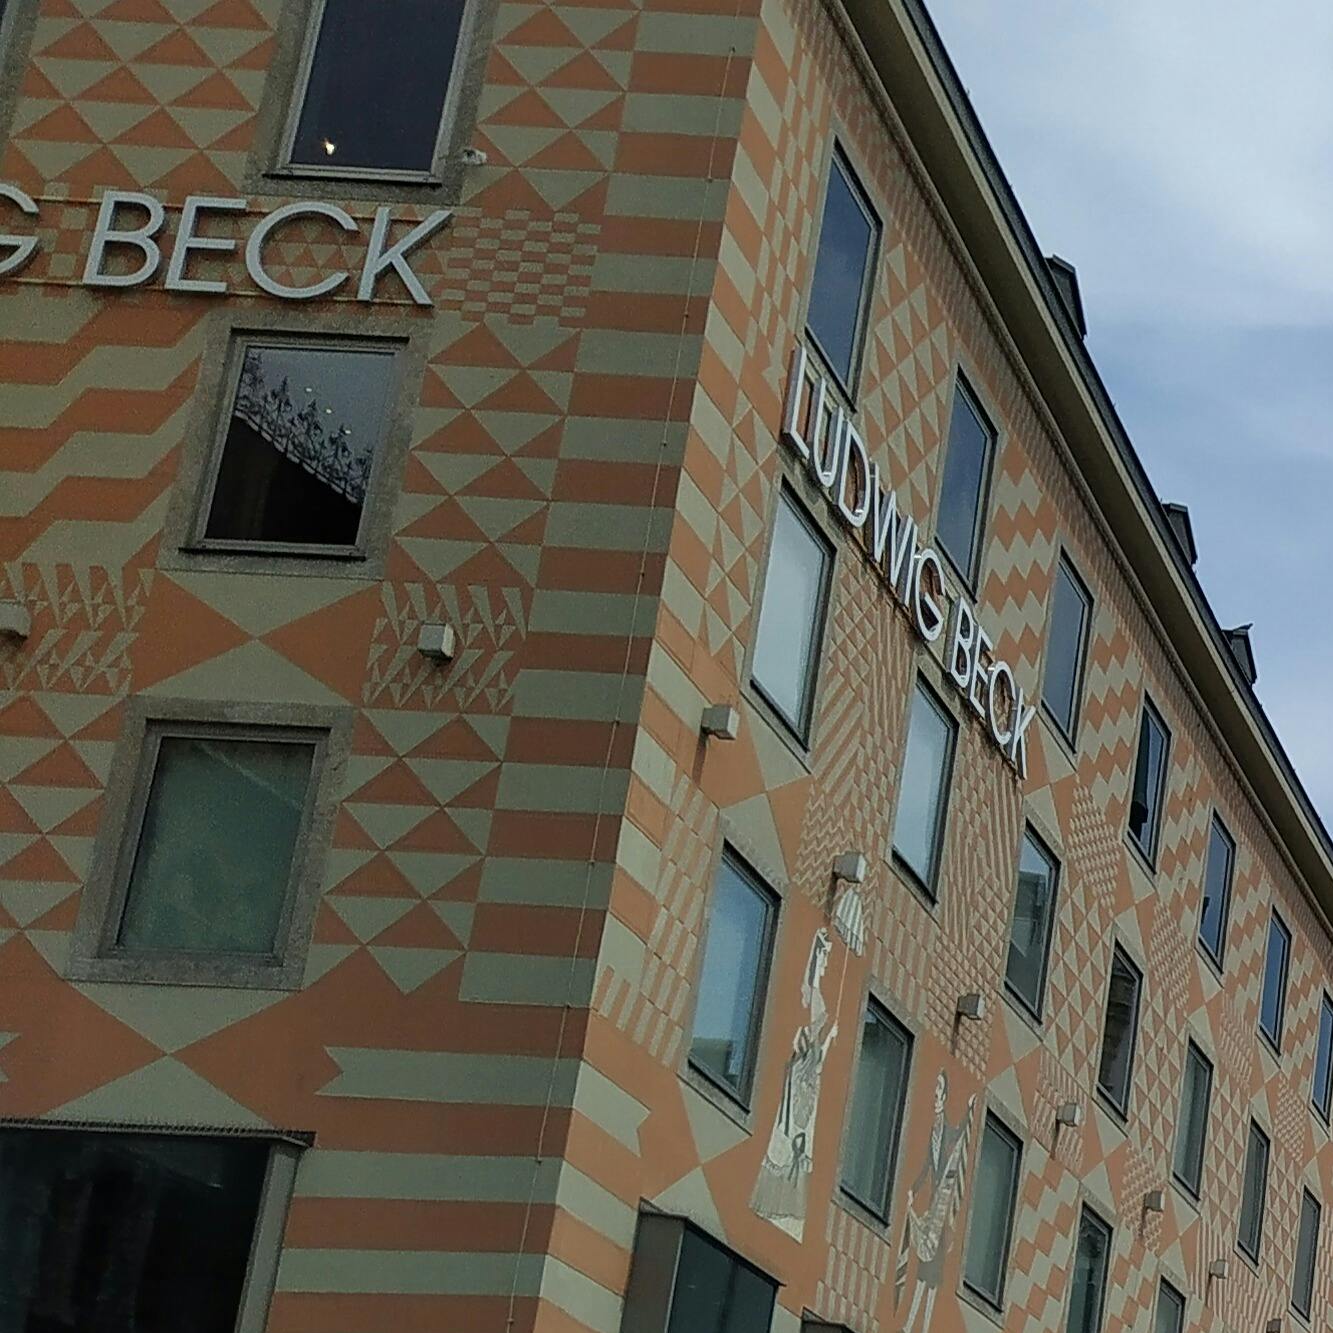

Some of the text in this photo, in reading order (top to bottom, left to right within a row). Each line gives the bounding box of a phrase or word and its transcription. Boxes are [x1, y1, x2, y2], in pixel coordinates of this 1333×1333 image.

[82, 190, 455, 306] BECK
[783, 346, 1036, 781] LUDWIG BECK
